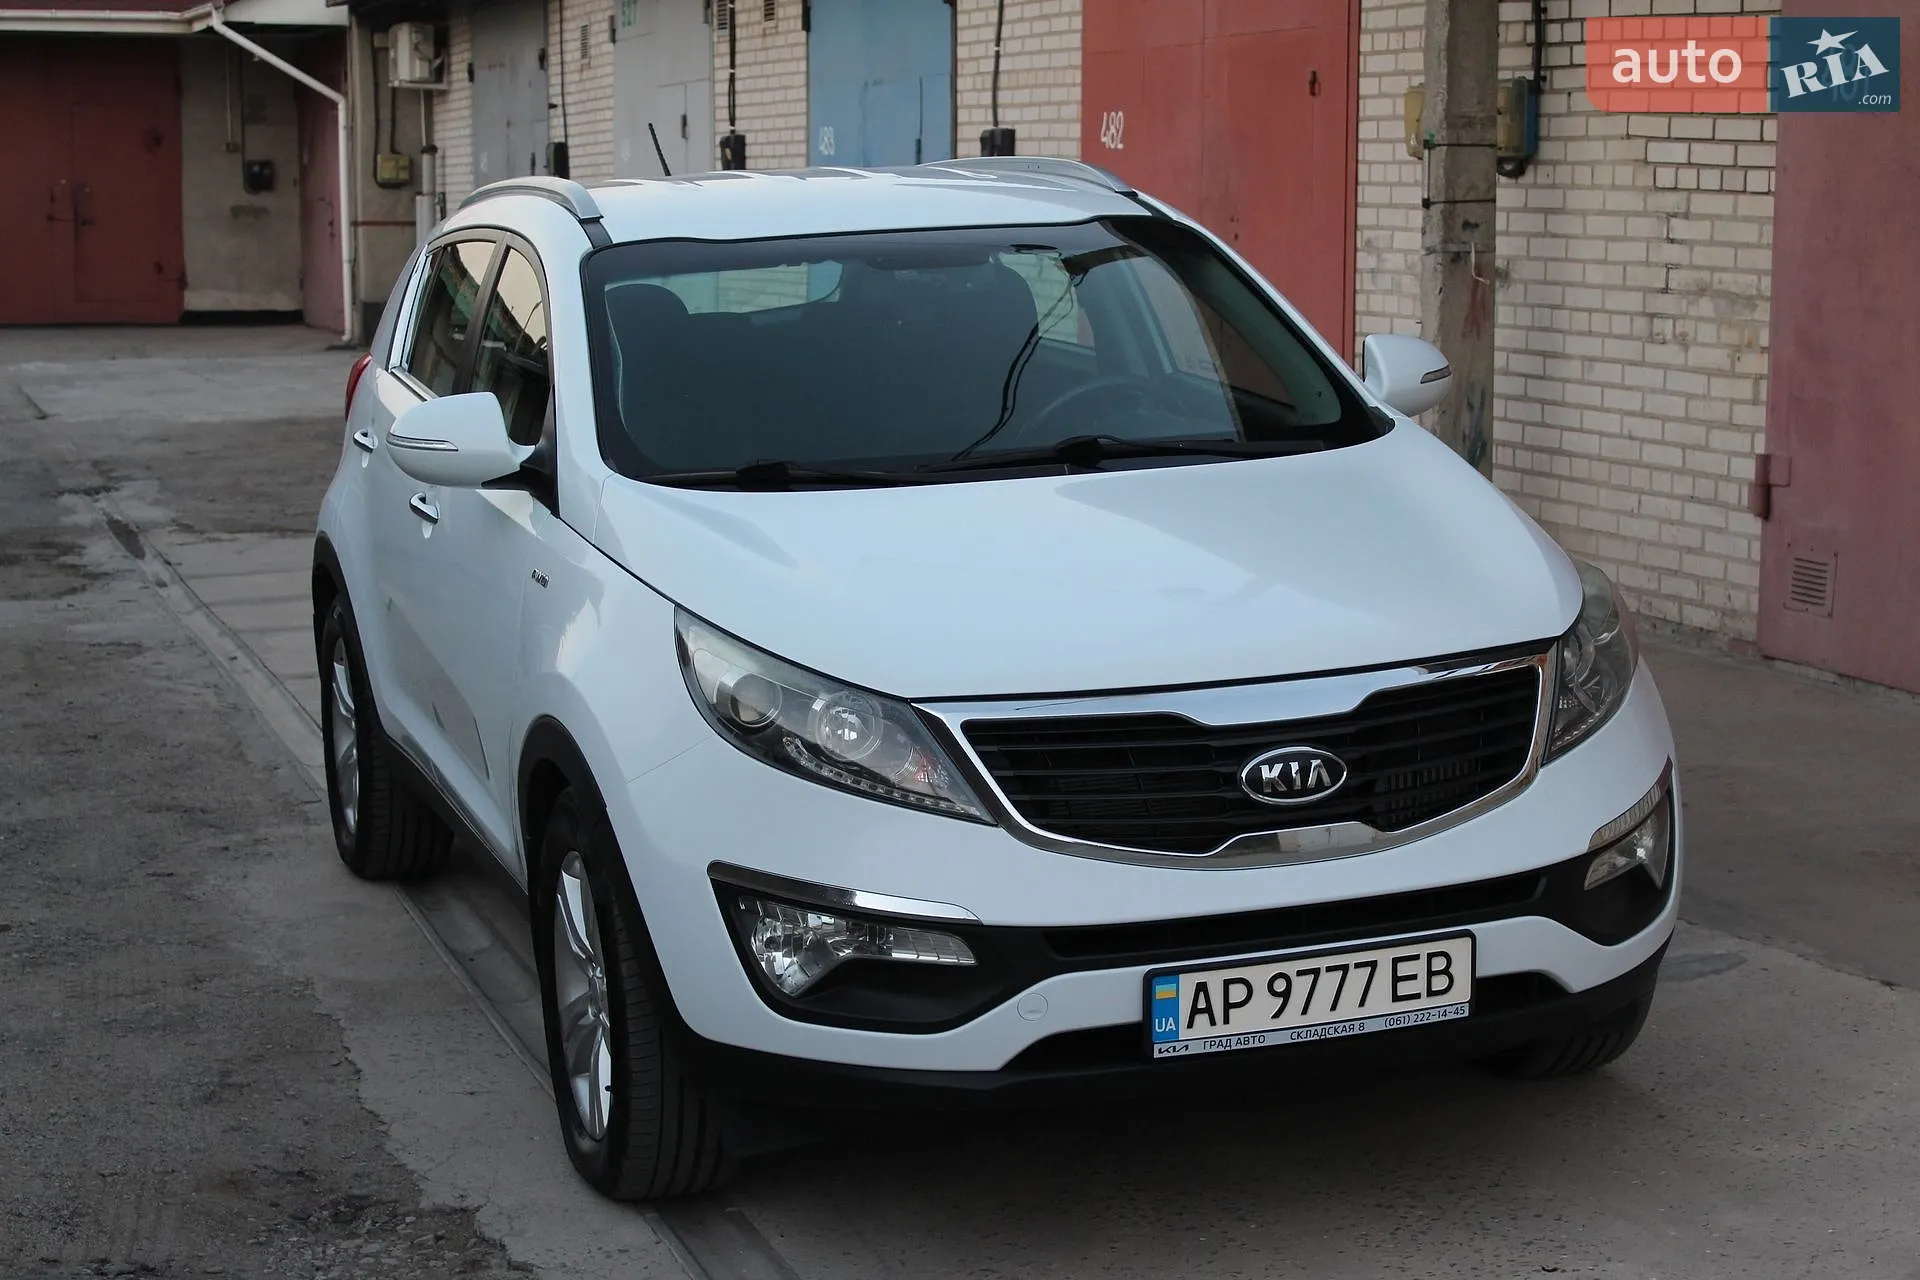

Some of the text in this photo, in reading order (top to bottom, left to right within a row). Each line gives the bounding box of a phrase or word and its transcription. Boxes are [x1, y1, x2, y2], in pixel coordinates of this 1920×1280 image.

[1101, 111, 1124, 149] 482
[1259, 759, 1332, 793] KIA
[1186, 951, 1455, 1030] AP 9777 EB
[1155, 1017, 1177, 1033] UA
[1384, 1005, 1466, 1028] (061) 222-14-45
[1203, 1034, 1266, 1050] ГРАД АВТО
[1290, 1022, 1366, 1041] СКЛАДСКАЯ 8
